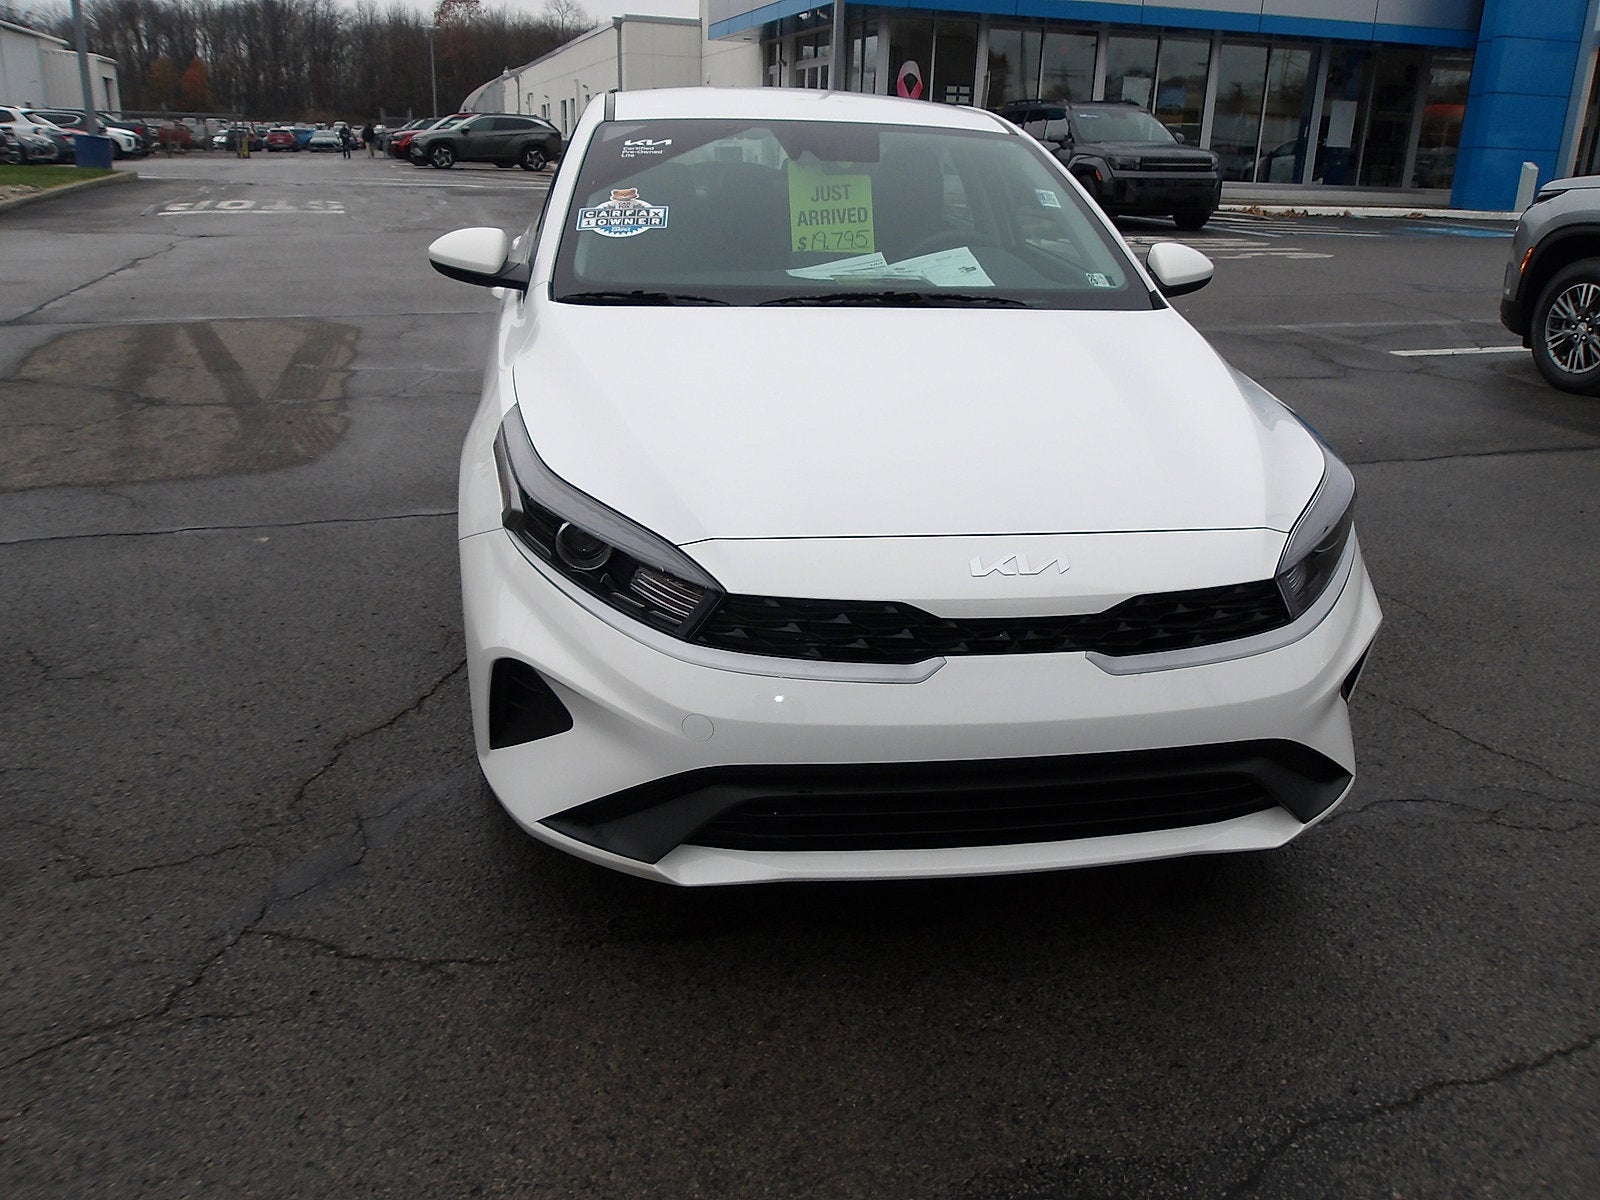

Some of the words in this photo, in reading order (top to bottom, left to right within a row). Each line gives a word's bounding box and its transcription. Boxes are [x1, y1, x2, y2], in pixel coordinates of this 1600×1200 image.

[811, 184, 851, 202] JUST
[585, 209, 661, 218] CARFAX
[597, 218, 661, 226] OWNER
[797, 207, 868, 227] ARRIVED
[968, 554, 1071, 578] KIA
